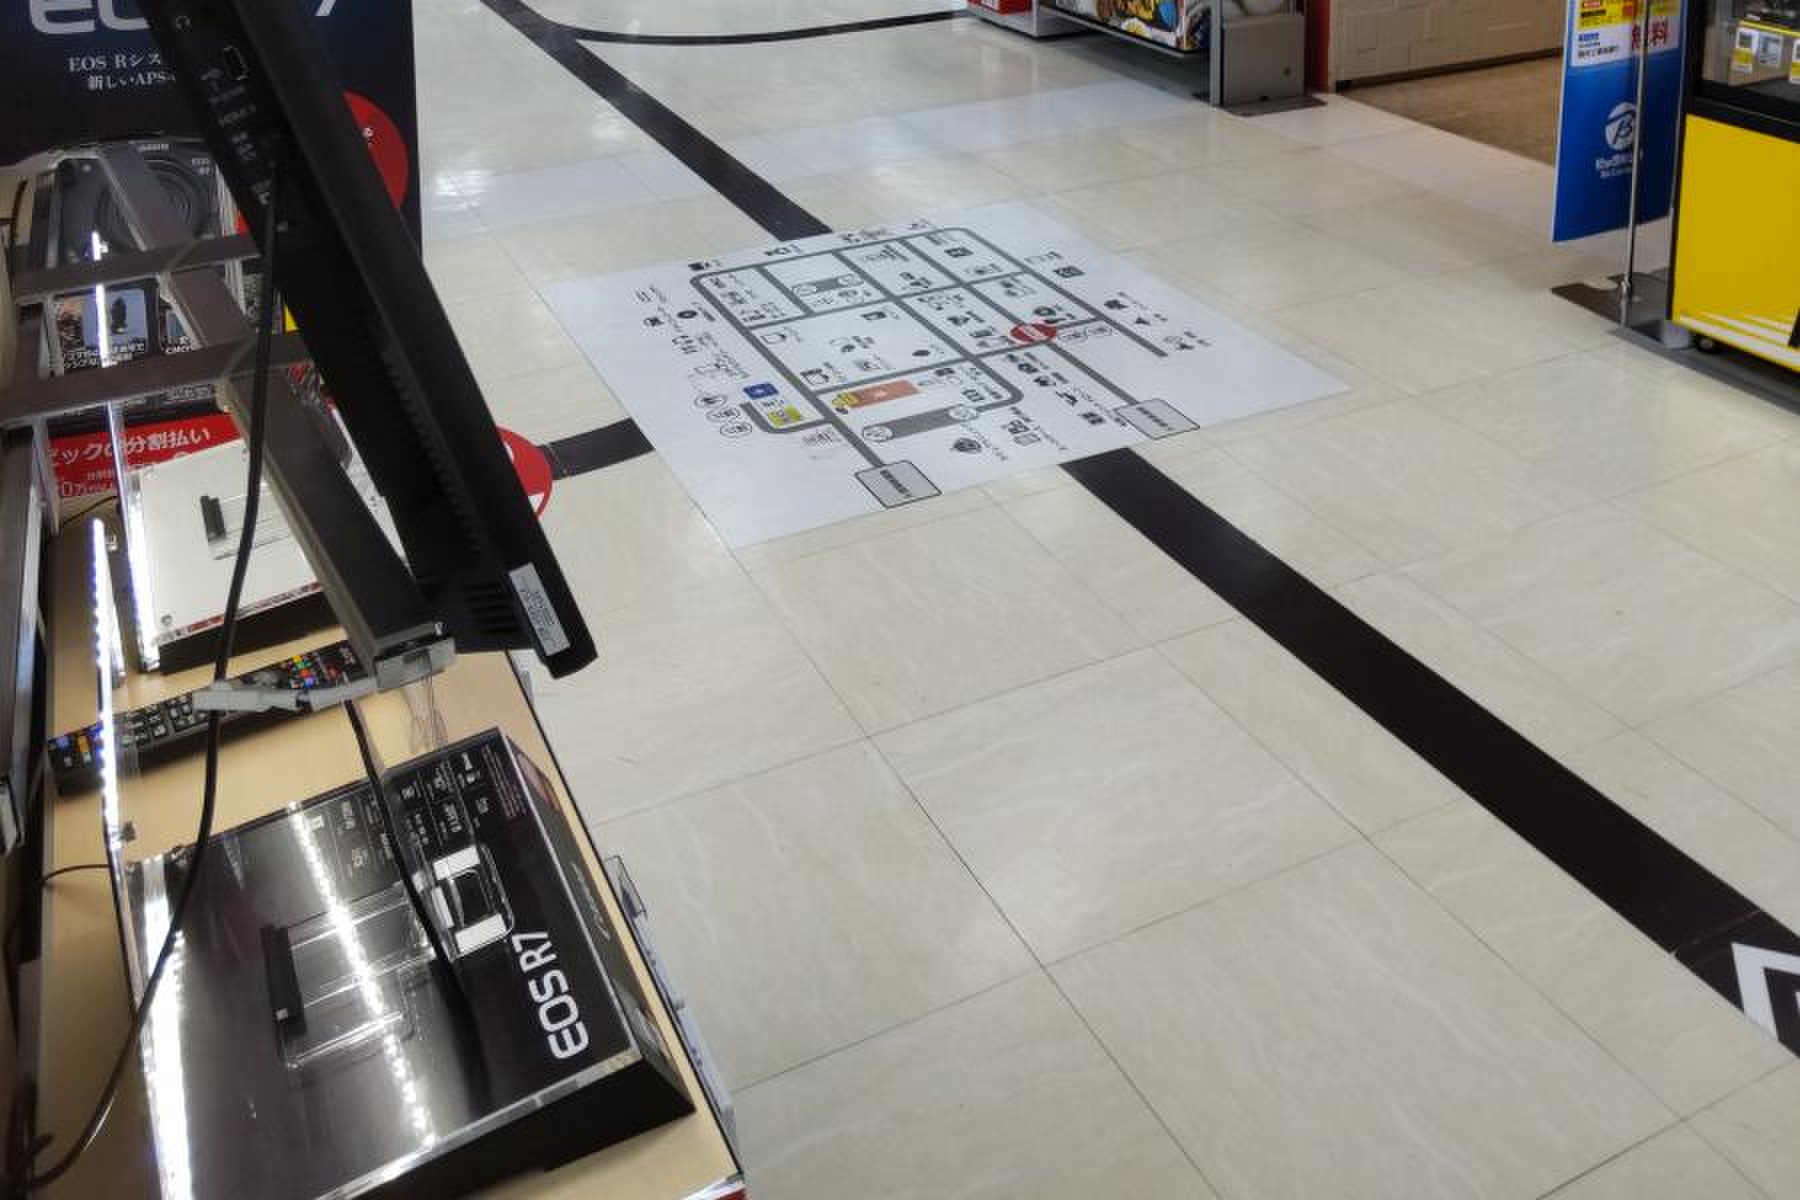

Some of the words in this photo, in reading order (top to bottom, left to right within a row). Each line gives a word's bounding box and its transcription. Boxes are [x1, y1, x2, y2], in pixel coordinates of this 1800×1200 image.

[69, 55, 107, 73] EOS
[511, 931, 557, 973] R7
[527, 969, 589, 1060] EOS
